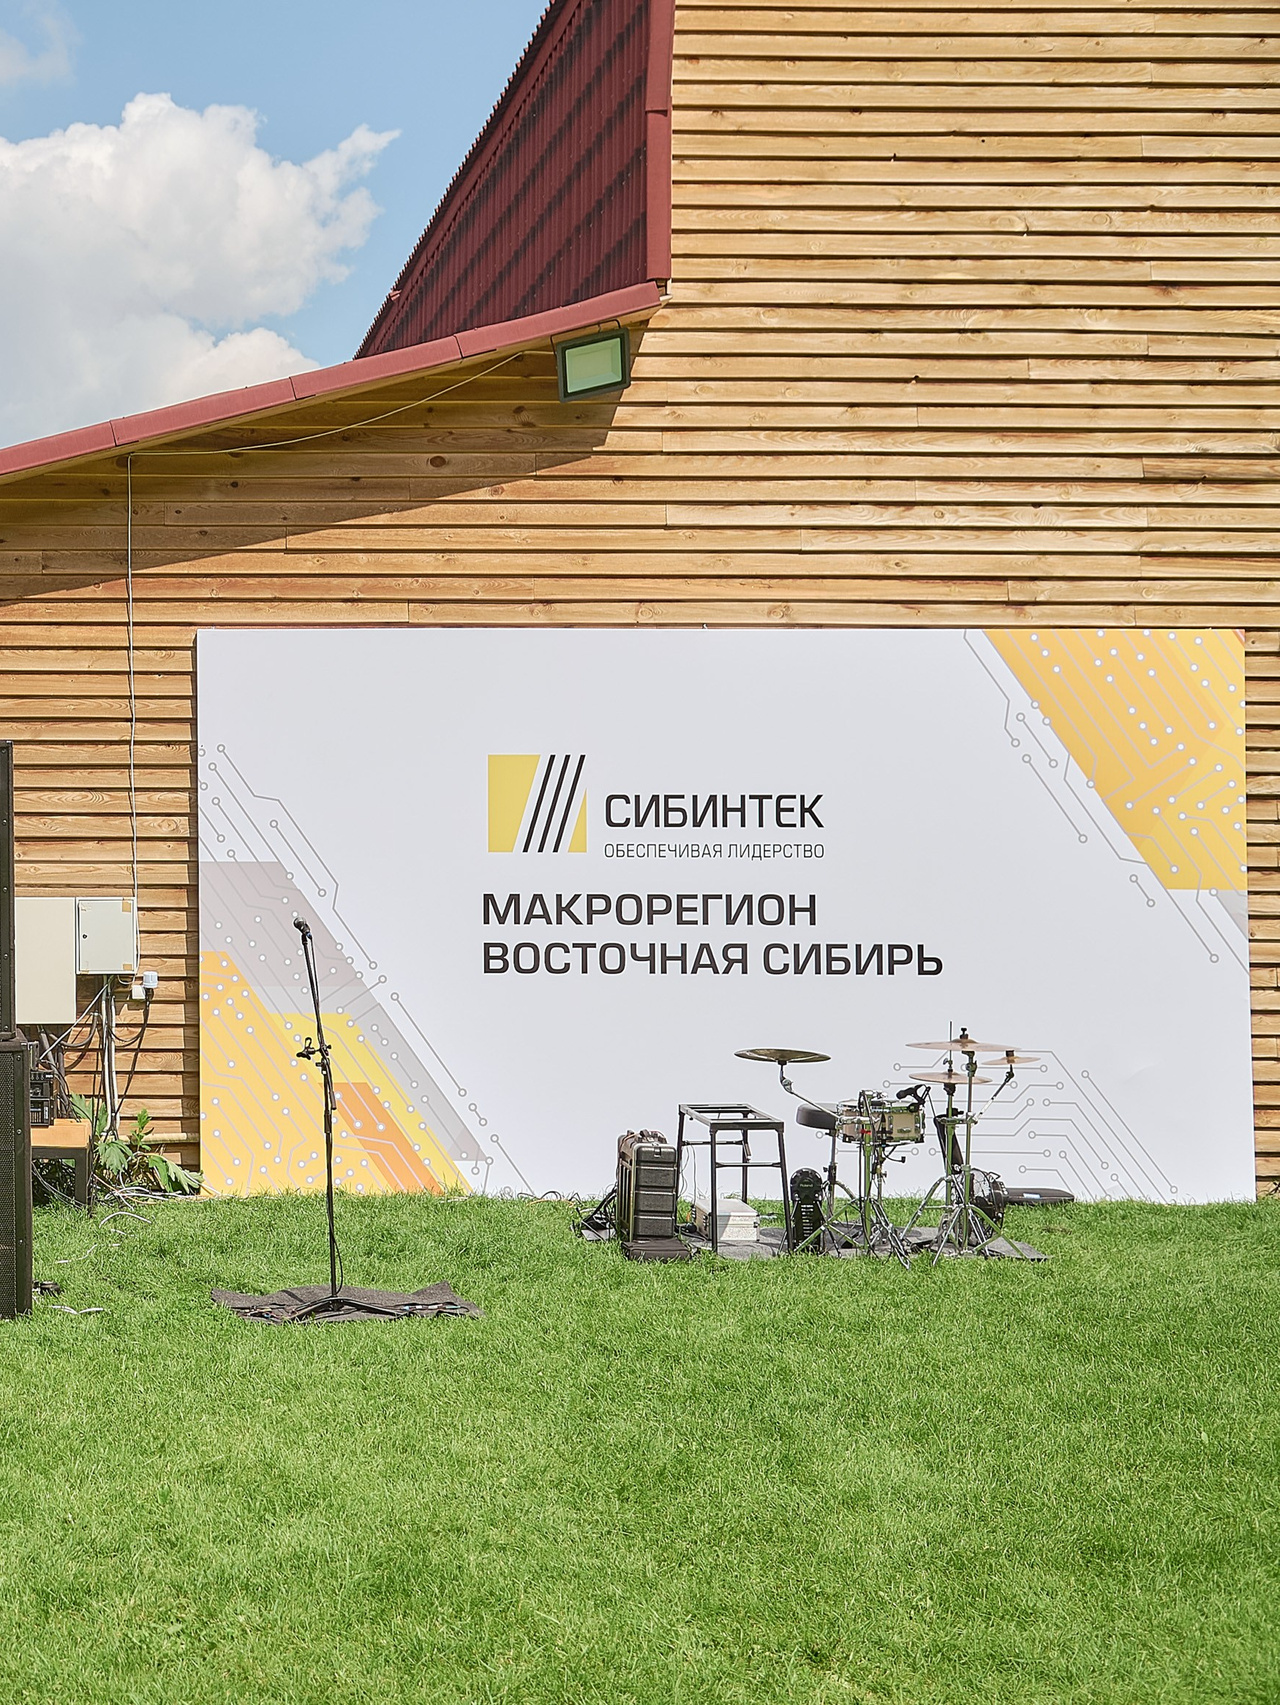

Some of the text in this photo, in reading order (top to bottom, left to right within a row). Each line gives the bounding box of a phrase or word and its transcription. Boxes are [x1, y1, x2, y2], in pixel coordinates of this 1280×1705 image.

[605, 794, 825, 828] СИБИНТЕК
[604, 843, 825, 861] ОБЕСПЕЧИВАЯ ЛИДЕРСТВО
[483, 893, 816, 926] МАКРОРЕГИОН
[483, 942, 943, 976] ВОСТОЧНАЯ СИБИРЬ
